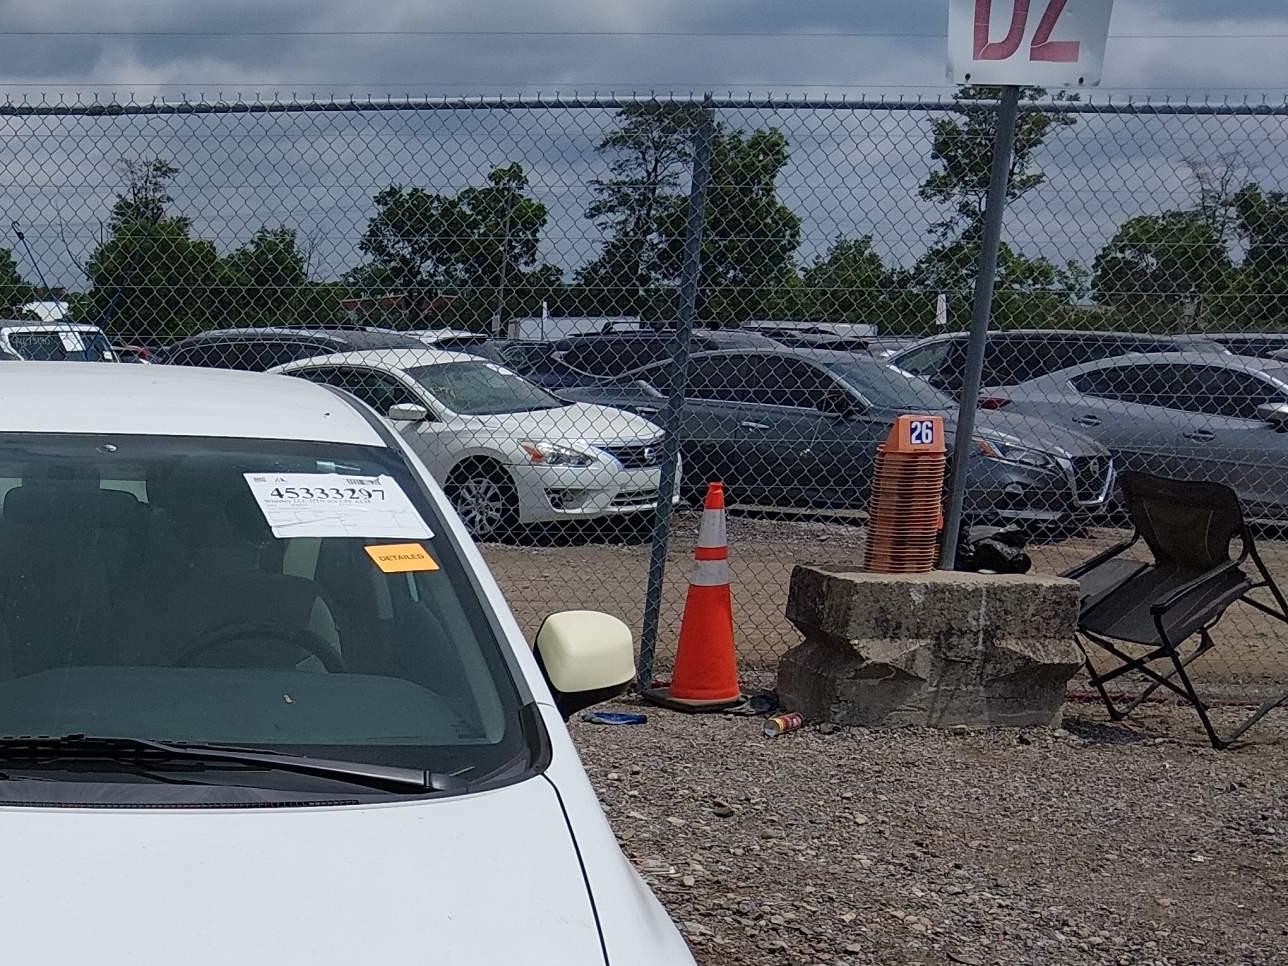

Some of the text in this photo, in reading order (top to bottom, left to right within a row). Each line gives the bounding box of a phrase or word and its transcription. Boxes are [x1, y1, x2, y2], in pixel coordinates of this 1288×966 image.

[911, 421, 933, 444] 26
[270, 487, 385, 500] 45333297
[378, 553, 425, 562] DETAILED
